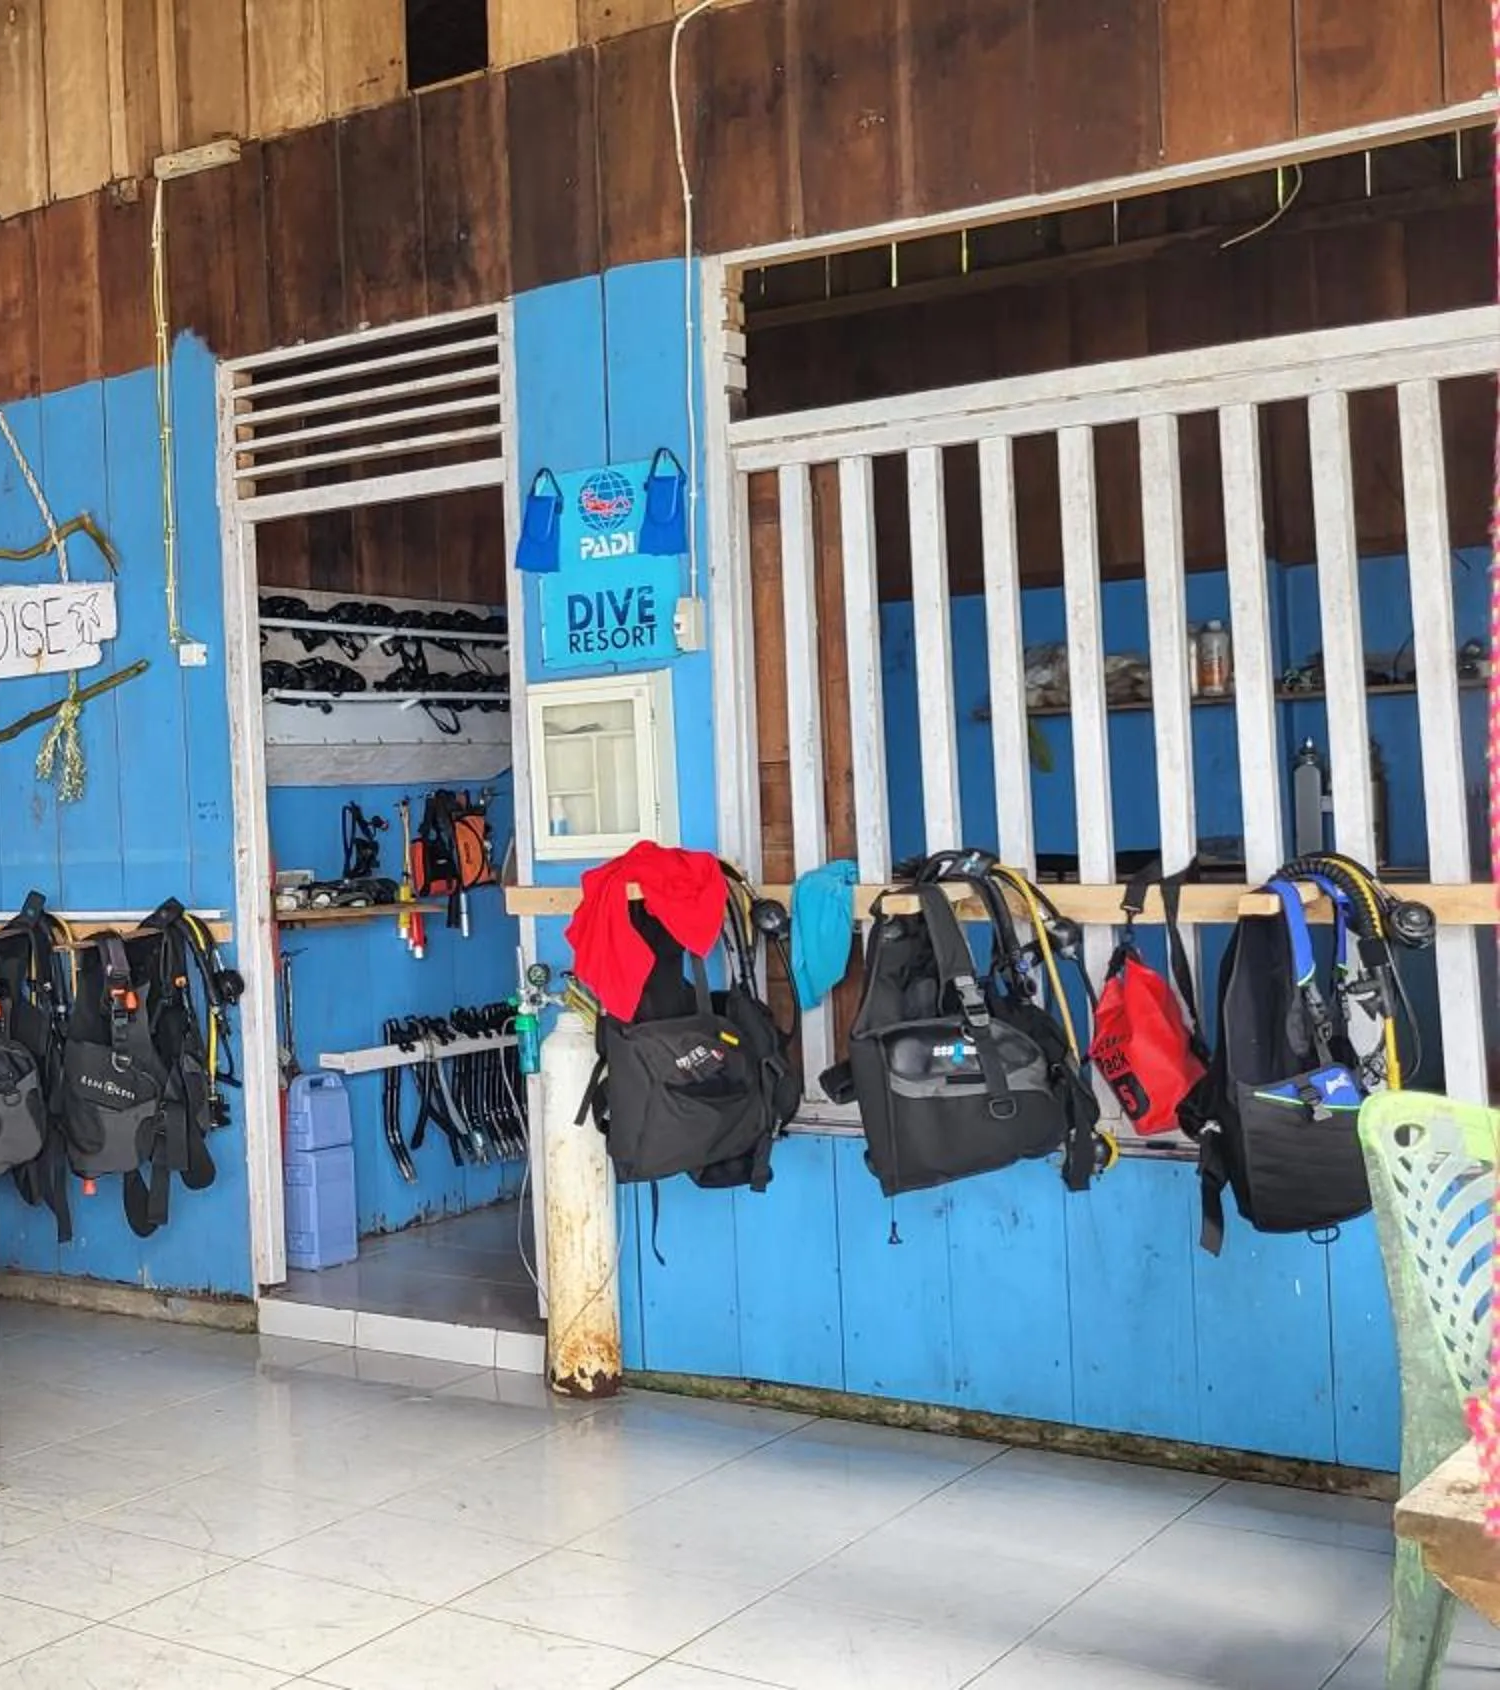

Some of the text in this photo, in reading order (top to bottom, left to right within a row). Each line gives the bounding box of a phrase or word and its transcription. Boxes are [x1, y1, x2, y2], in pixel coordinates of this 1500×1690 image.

[580, 531, 636, 560] PADI
[567, 585, 656, 631] DIVE
[569, 624, 658, 654] RESORT
